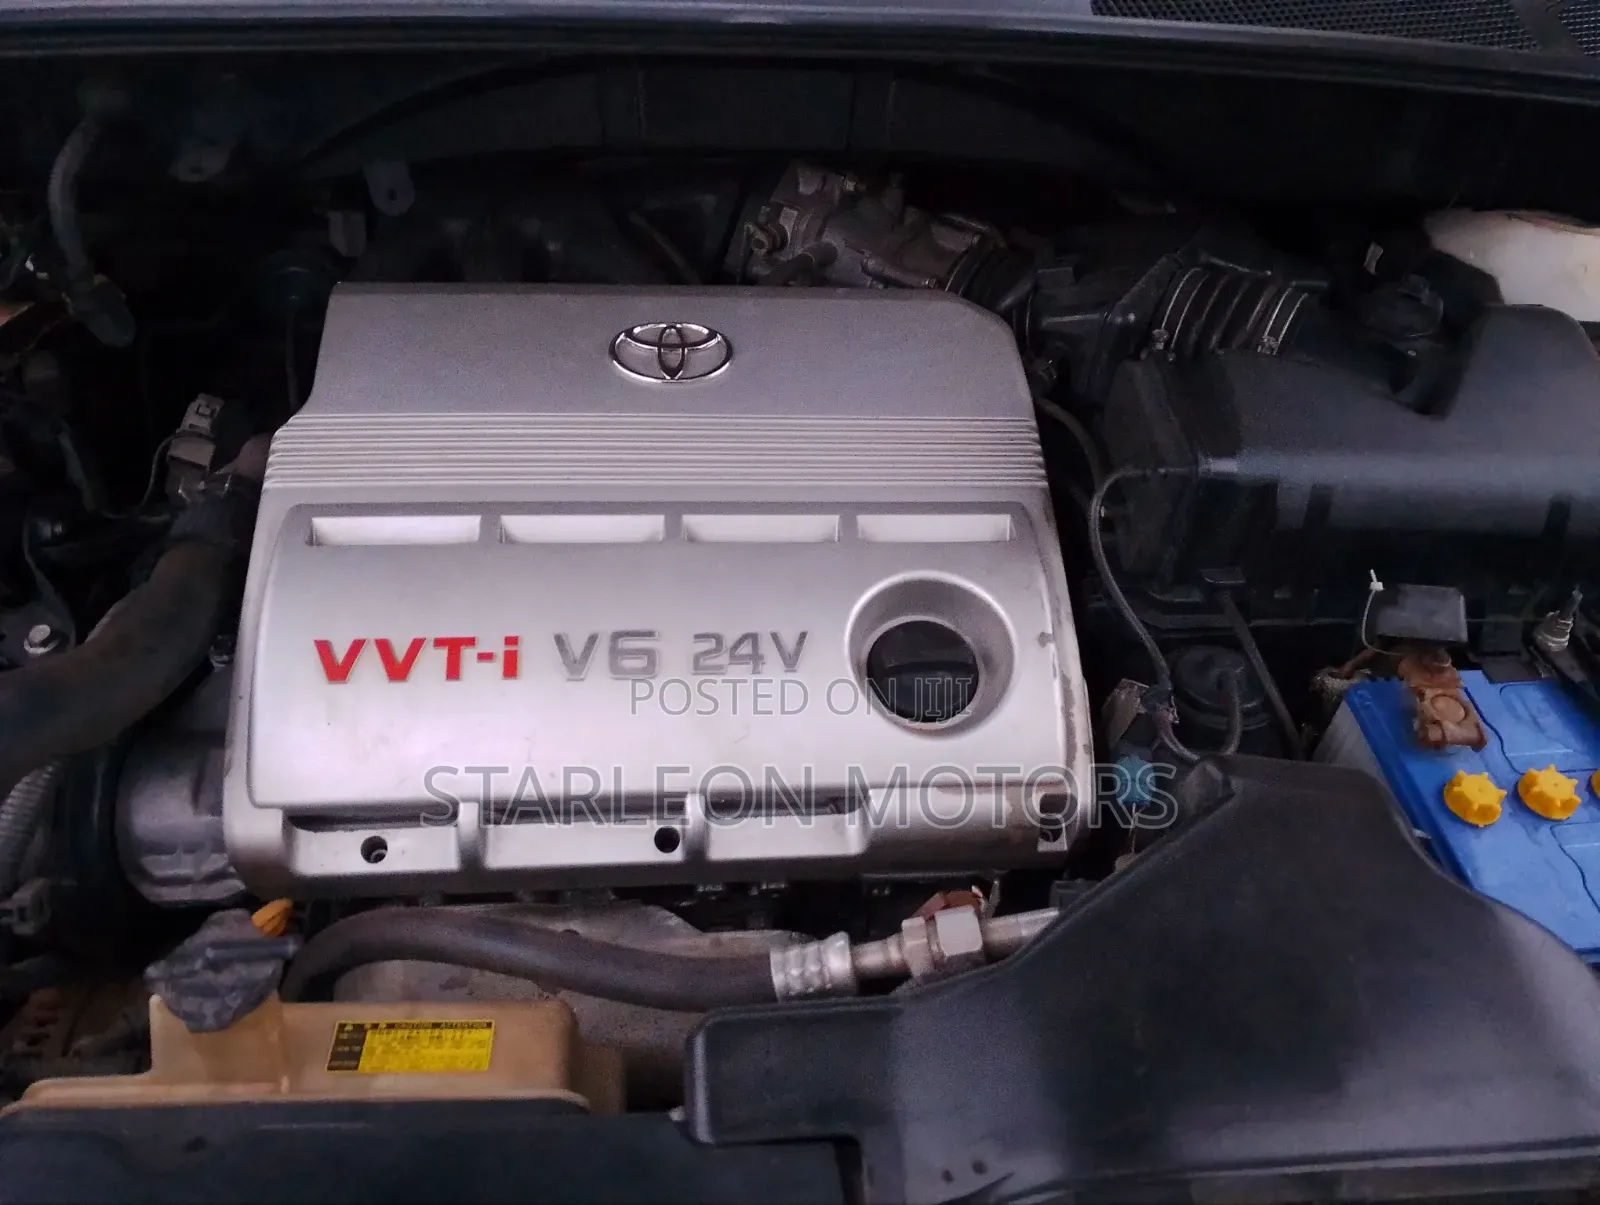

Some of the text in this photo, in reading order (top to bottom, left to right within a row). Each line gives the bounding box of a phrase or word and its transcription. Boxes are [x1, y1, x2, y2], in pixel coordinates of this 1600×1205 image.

[313, 630, 808, 684] VVT-i V6 24V
